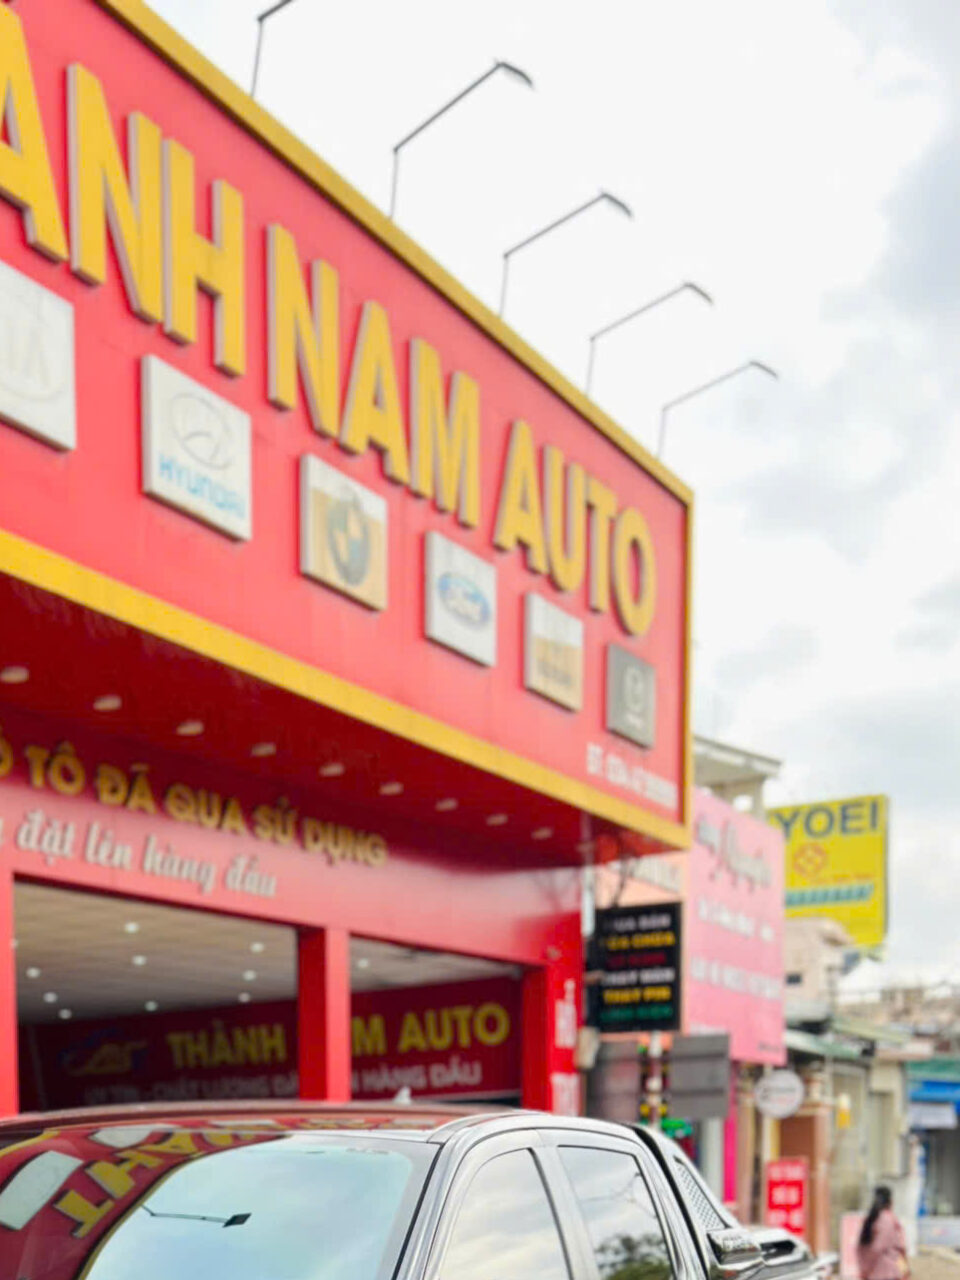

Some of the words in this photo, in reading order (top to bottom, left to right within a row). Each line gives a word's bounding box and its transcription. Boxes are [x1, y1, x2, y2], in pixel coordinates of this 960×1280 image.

[266, 222, 479, 529] NAM
[493, 418, 657, 636] AUTO
[16, 809, 76, 865] đặt
[85, 820, 133, 872] lên
[143, 833, 218, 895] hàng
[225, 852, 278, 899] đầu
[24, 741, 86, 796] TÔ
[94, 763, 158, 816] ĐÃ
[165, 784, 247, 837] QUA
[303, 818, 390, 868] DỤNG
[165, 1018, 287, 1068] THÀNH
[398, 1002, 510, 1052] AUTO
